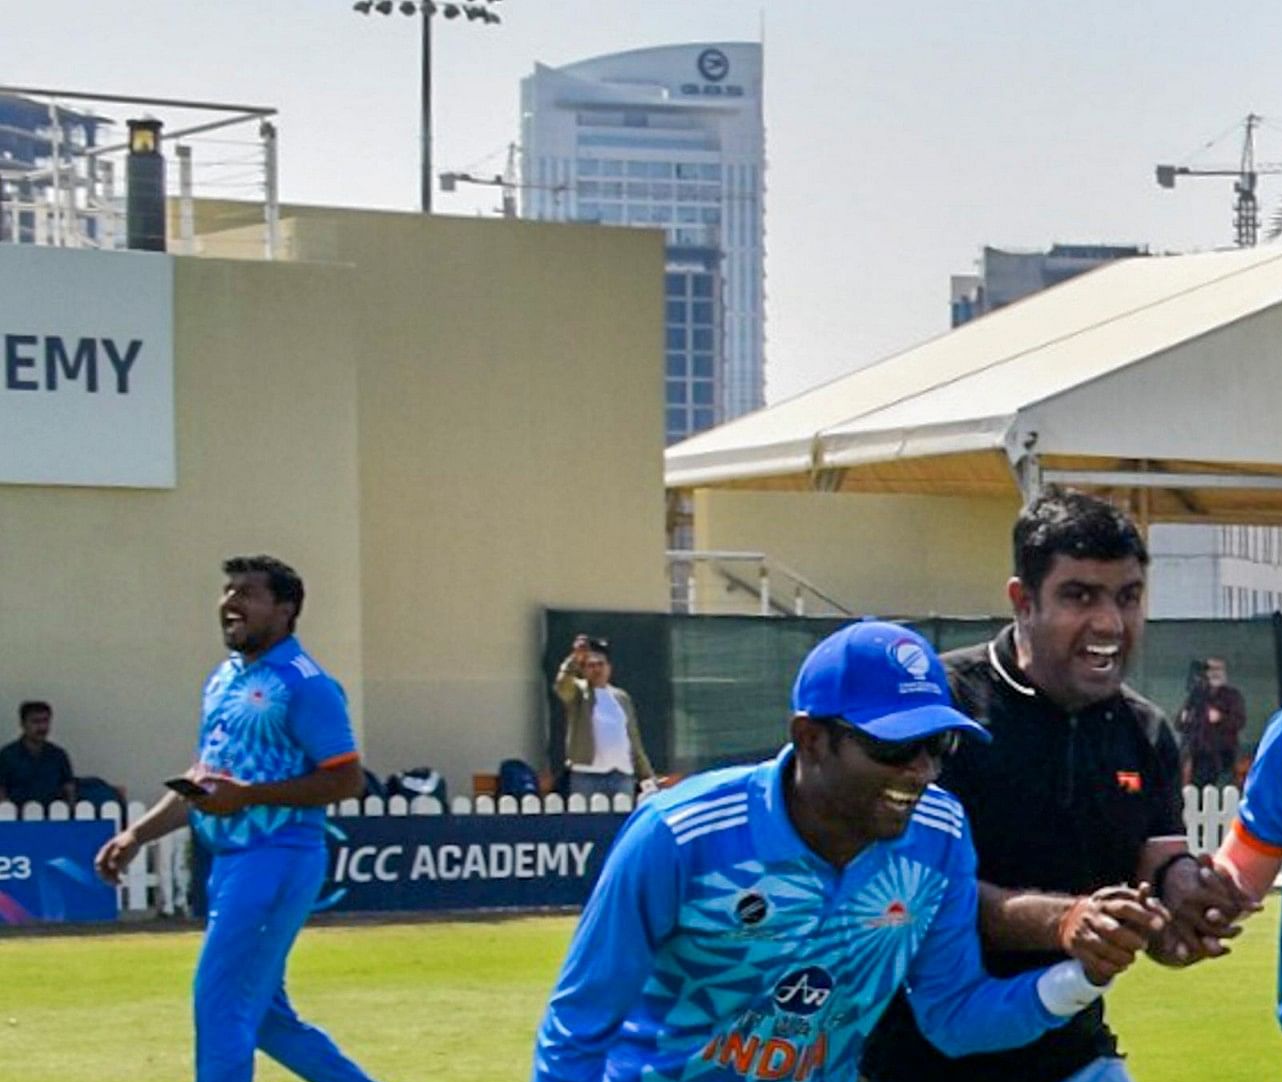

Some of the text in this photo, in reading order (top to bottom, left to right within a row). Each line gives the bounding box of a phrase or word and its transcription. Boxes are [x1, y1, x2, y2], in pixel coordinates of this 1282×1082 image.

[5, 334, 143, 393] EMY
[334, 842, 593, 882] ICC ACADEMY
